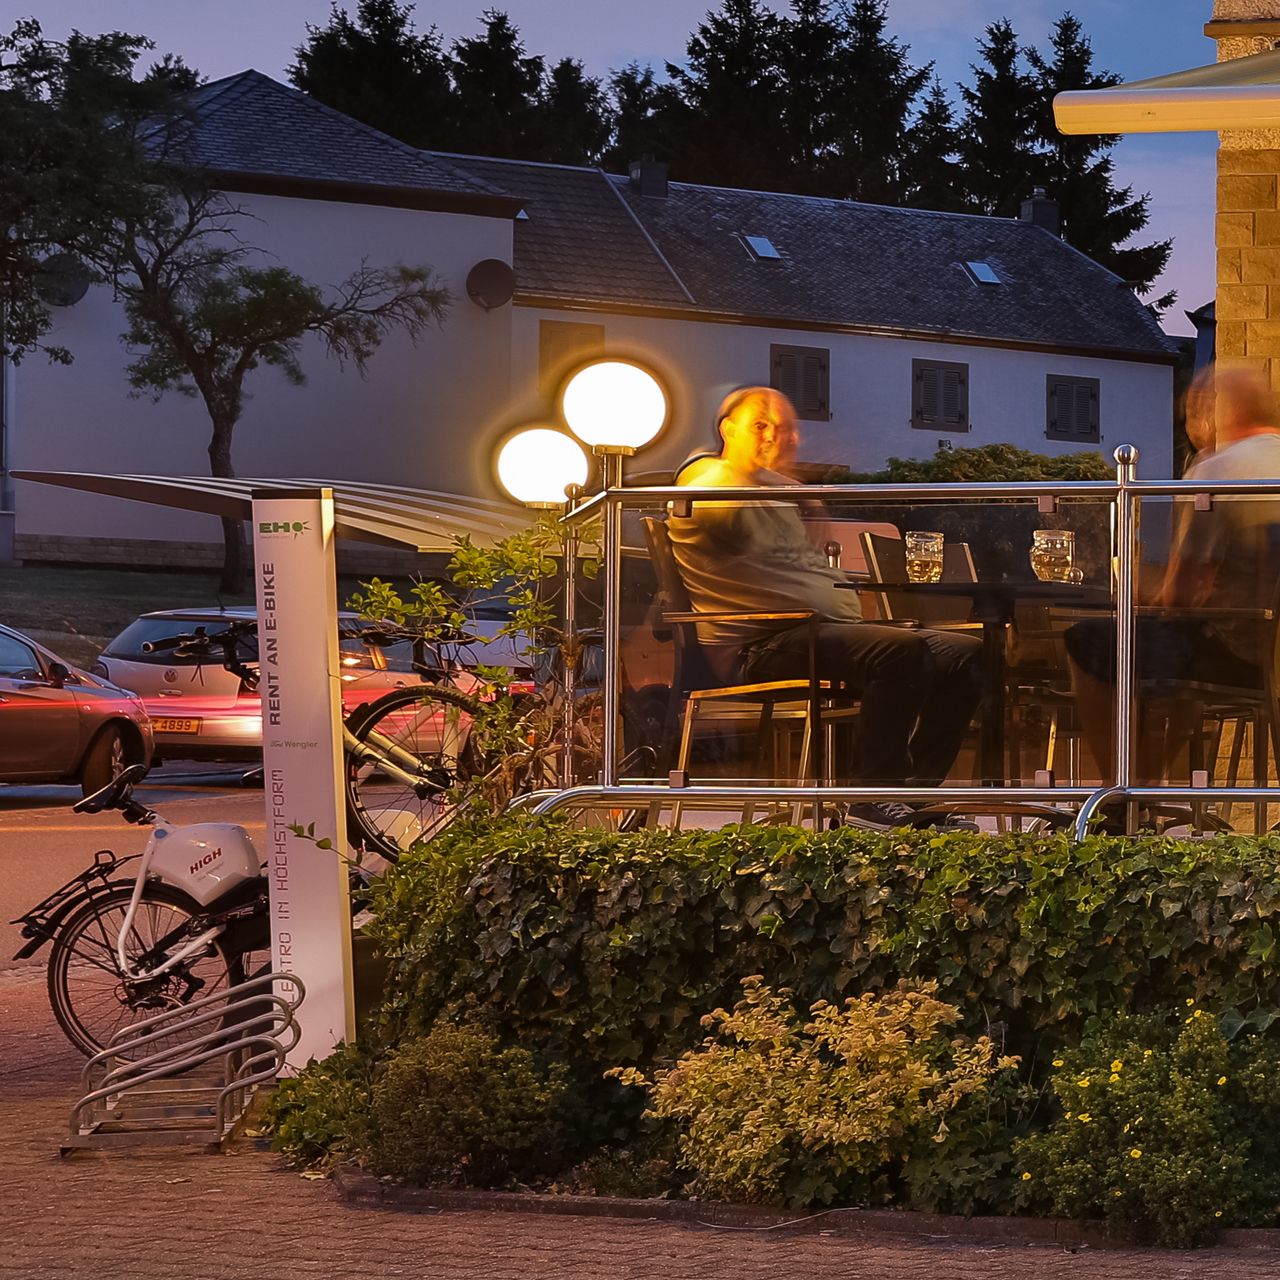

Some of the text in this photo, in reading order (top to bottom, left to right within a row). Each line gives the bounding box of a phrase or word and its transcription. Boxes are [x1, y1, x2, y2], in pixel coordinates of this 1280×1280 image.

[262, 563, 277, 631] E-BIKE
[266, 637, 279, 667] AN
[268, 671, 281, 726] RENT
[271, 769, 290, 891] HÖCHSTFORM
[190, 847, 222, 874] HIGH
[277, 901, 291, 920] IN
